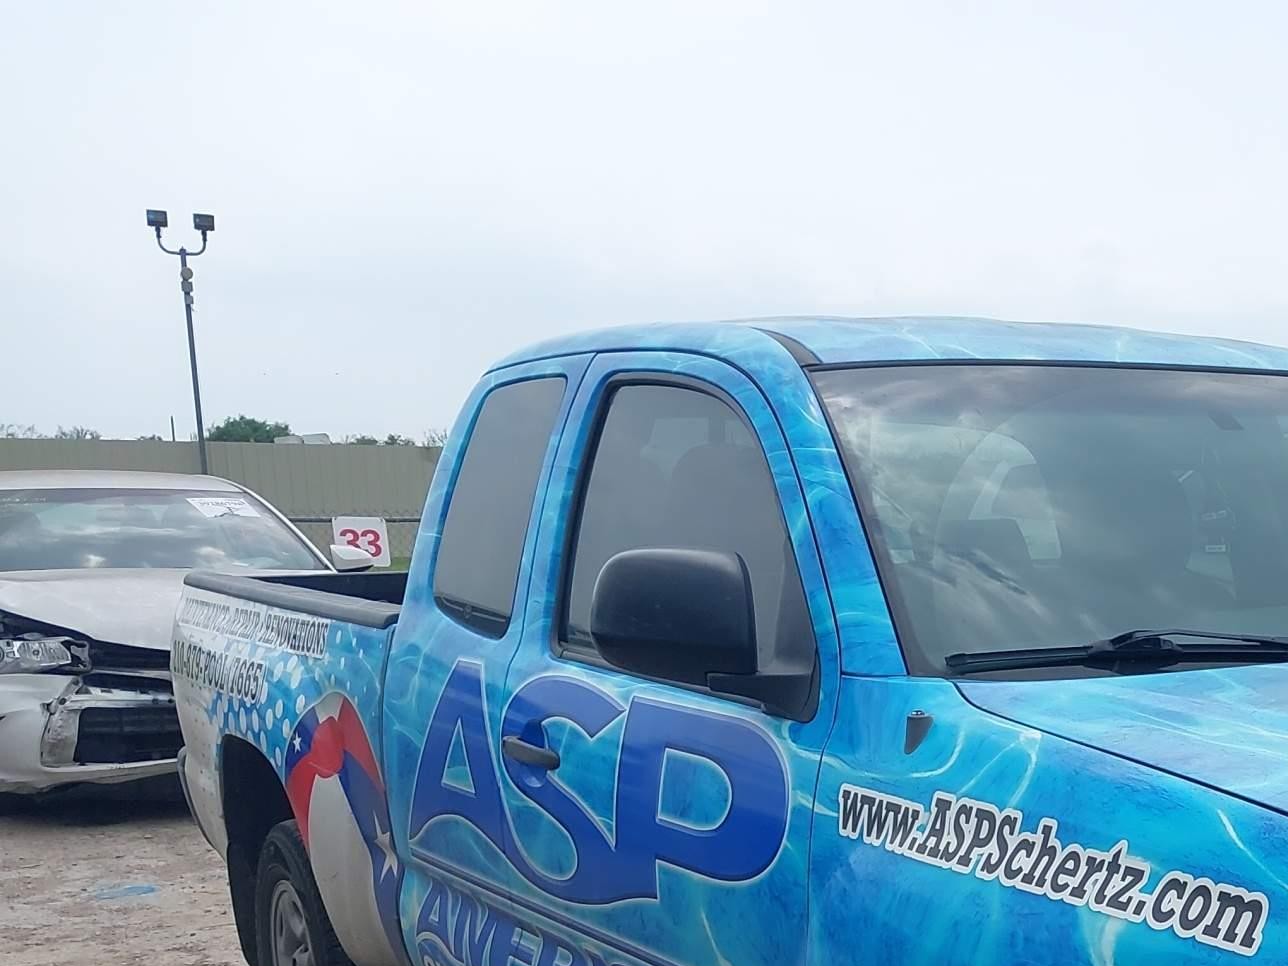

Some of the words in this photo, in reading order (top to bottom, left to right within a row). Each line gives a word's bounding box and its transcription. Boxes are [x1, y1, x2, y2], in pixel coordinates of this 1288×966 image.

[339, 528, 382, 558] 33
[259, 613, 329, 656] RENOVATIONS
[410, 659, 788, 905] ASP
[840, 789, 1266, 949] www.ASPSchertz.com
